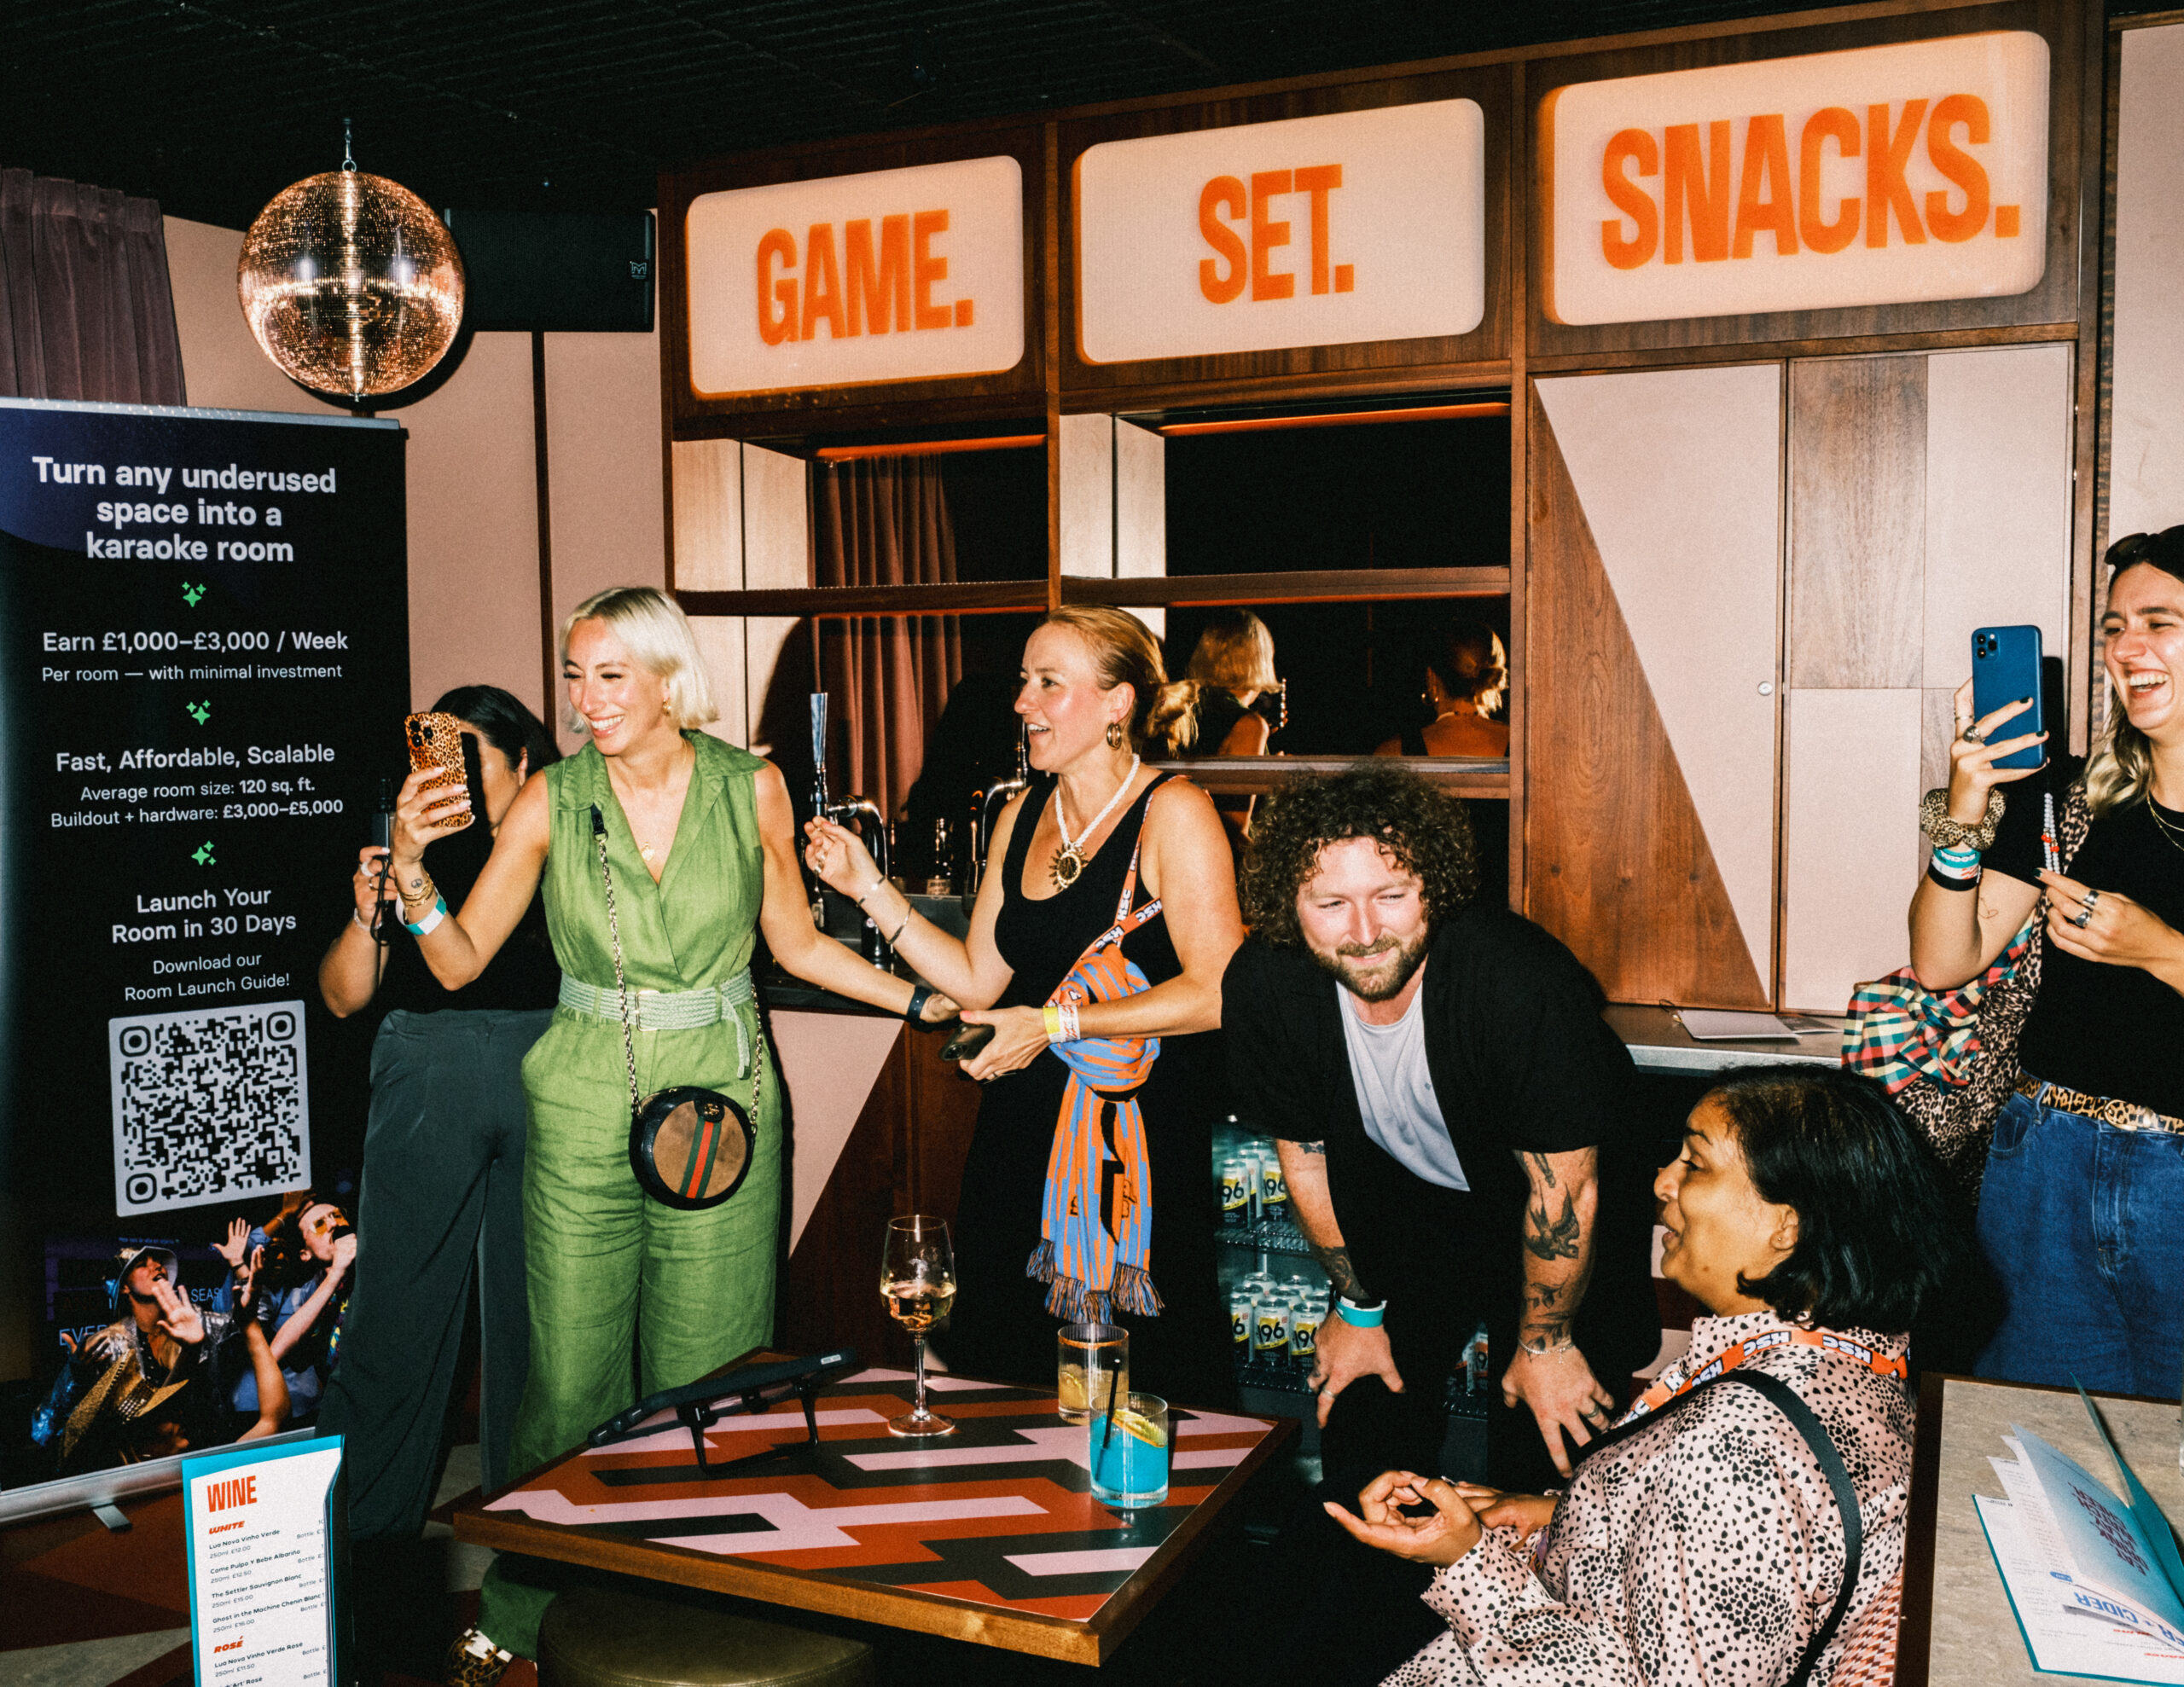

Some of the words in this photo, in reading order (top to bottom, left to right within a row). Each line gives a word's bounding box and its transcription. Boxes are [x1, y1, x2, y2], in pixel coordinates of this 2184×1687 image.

[1601, 94, 2020, 270] SNACKS.
[1199, 163, 1355, 304] SET.
[757, 209, 974, 346] GAME.
[31, 455, 106, 484] Turn
[116, 466, 172, 495] any
[183, 464, 336, 493] underused
[97, 501, 189, 530] space
[198, 498, 256, 525] into
[266, 507, 282, 525] a
[87, 530, 208, 559] karaoke
[217, 541, 293, 561] room
[43, 633, 96, 652] Earn
[102, 631, 270, 653] £1,000–£3,000
[276, 631, 285, 652] /
[292, 631, 348, 650] Week
[43, 667, 70, 682] Per
[77, 670, 118, 681] room
[148, 665, 184, 681] with
[189, 664, 251, 679] minimal
[258, 665, 343, 679] investment
[56, 752, 111, 773] Fast,
[119, 747, 241, 769] Affordable,
[247, 744, 334, 764] Scalable
[80, 786, 148, 803] Average
[154, 785, 195, 797] room
[201, 781, 234, 795] size:
[239, 780, 266, 793] 120
[271, 781, 293, 795] sq.
[297, 776, 316, 791] ft.
[51, 810, 119, 827] Buildout
[125, 812, 135, 822] +
[140, 807, 218, 822] hardware:
[224, 800, 343, 820] £3,000–£5,000
[136, 889, 217, 913] Launch
[224, 889, 271, 906] Your
[113, 925, 176, 943] Room
[184, 919, 203, 938] in
[210, 916, 237, 935] 30
[246, 914, 297, 935] Days
[154, 954, 230, 974] Download
[237, 955, 261, 967] our
[125, 988, 172, 1001] Room
[177, 977, 235, 996] Launch
[241, 972, 290, 989] Guide!
[1222, 1181, 1244, 1203] 96
[207, 1475, 257, 1513] WINE
[209, 1521, 245, 1534] WHITE
[223, 1538, 240, 1546] Nova
[241, 1533, 259, 1542] Vinho
[261, 1529, 280, 1538] Verde
[230, 1561, 248, 1570] Pulpo
[256, 1555, 272, 1564] Bebe
[225, 1586, 248, 1596] Settler
[249, 1579, 283, 1591] Sauvignon
[284, 1574, 302, 1582] Blanc
[212, 1615, 232, 1624] Ghost
[253, 1603, 281, 1614] Machine
[282, 1598, 303, 1607] Chenin
[2074, 1591, 2139, 1624] CIDER
[213, 1636, 243, 1654] ROSÉ
[247, 1651, 265, 1660] Vinho
